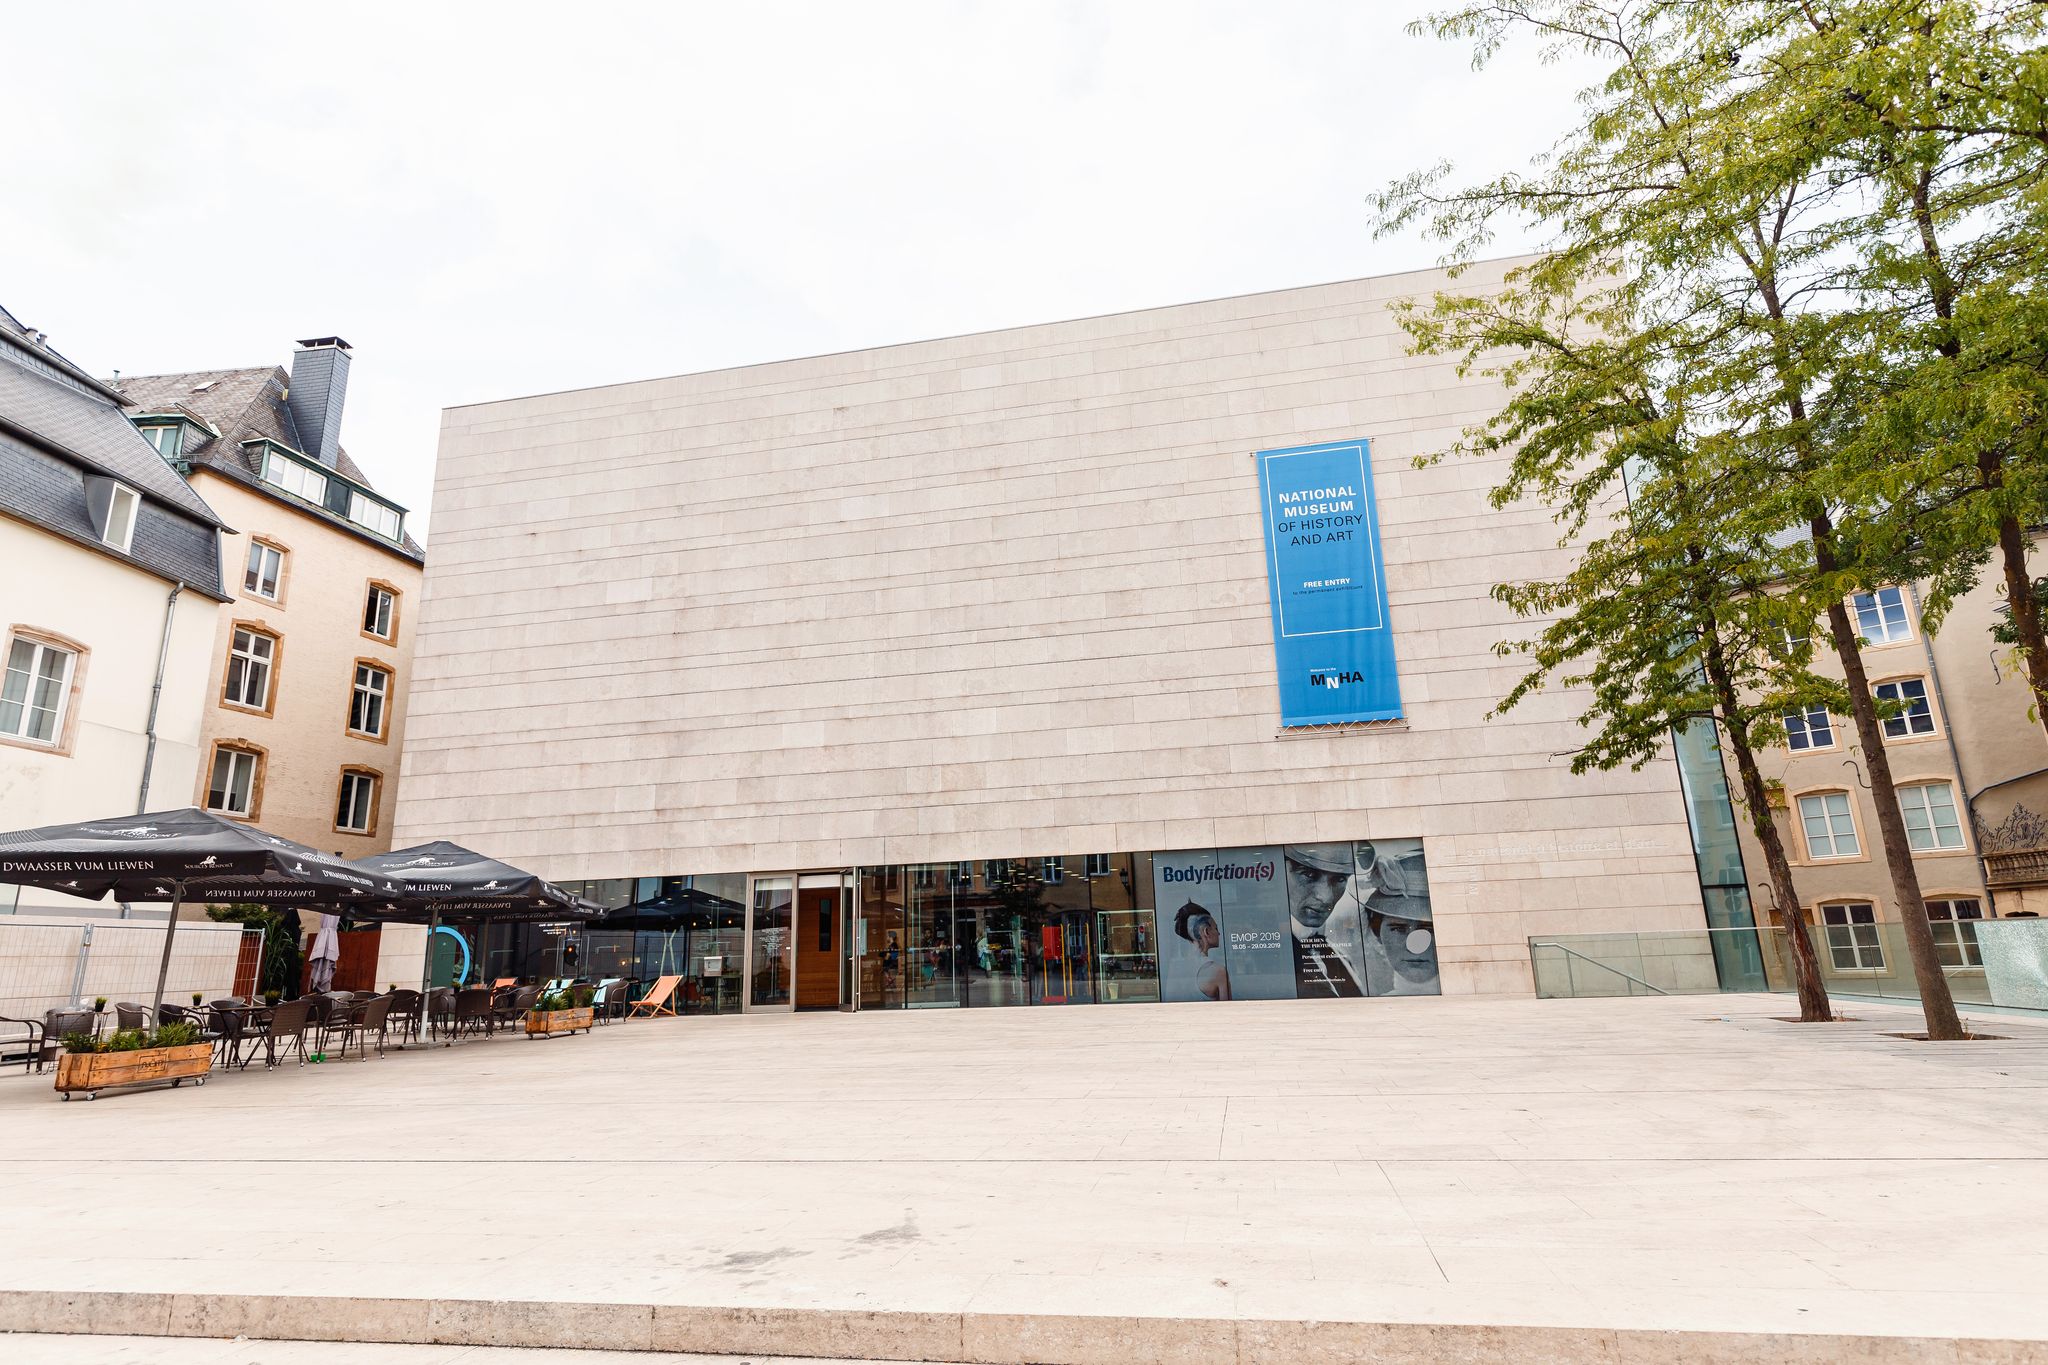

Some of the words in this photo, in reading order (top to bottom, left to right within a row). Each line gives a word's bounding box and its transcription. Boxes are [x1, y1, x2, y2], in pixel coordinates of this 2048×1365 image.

[1279, 486, 1357, 504] NATIONAL
[1284, 501, 1353, 517] MUSEUM
[1278, 521, 1296, 532] OF
[1301, 514, 1363, 531] HISTORY
[1291, 534, 1322, 546] AND
[1326, 530, 1353, 543] ART
[1325, 578, 1351, 587] ENTRY
[1311, 671, 1364, 690] MNHA
[3, 861, 73, 872] D'WAASSER
[75, 861, 104, 871] VUM
[108, 860, 154, 871] LIEWEN
[1163, 861, 1275, 884] Bodyfiction(s)
[418, 883, 452, 892] LIEWEN
[1231, 932, 1258, 943] EMOP
[1260, 931, 1281, 941] 2019
